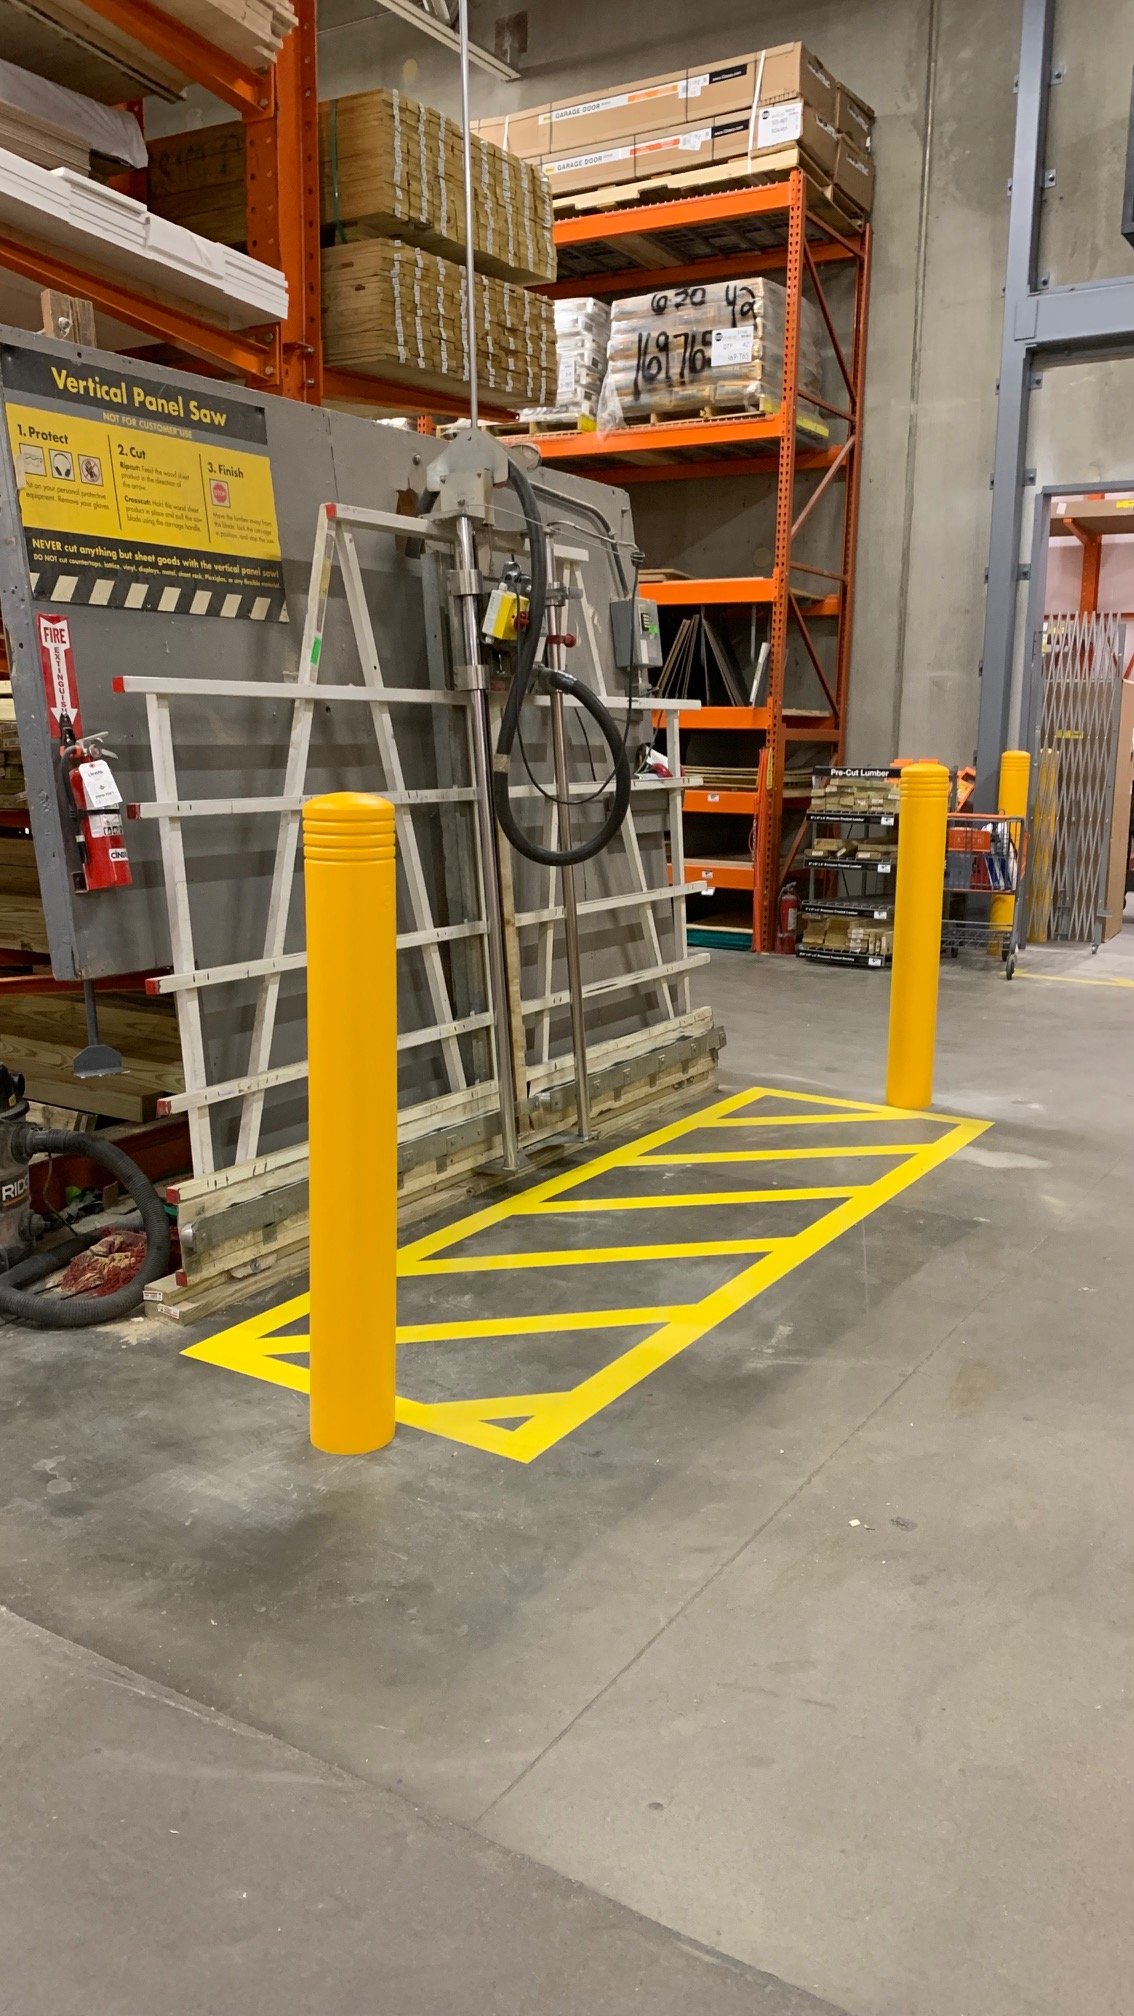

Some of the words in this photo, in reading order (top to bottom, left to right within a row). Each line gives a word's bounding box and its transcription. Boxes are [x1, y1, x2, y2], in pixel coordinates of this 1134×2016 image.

[555, 108, 580, 119] GARAGE
[582, 103, 600, 113] DOOR
[557, 160, 582, 171] GARAGE
[584, 155, 602, 165] DOOR
[51, 366, 127, 404] Vertical
[133, 386, 184, 417] Panel
[188, 400, 227, 427] Saw
[17, 424, 27, 437] 1.
[28, 425, 68, 444] Protect
[102, 412, 119, 423] NOT
[121, 414, 137, 426] FOR
[139, 418, 180, 435] CUSTOMER
[179, 428, 193, 439] USE
[117, 443, 128, 456] 2.
[129, 446, 146, 460] Cut
[207, 461, 217, 473] 3.
[218, 463, 244, 479] Finish
[32, 538, 62, 552] NEVER
[64, 543, 77, 553] cut
[79, 545, 117, 560] anything
[118, 548, 132, 560] but
[134, 550, 156, 563] sheet
[157, 556, 180, 566] goods
[182, 558, 199, 568] with
[200, 560, 212, 570] the
[213, 563, 240, 574] vertical
[241, 567, 261, 577] panel
[44, 554, 57, 562] NOT
[43, 627, 67, 644] FIRE
[830, 768, 859, 777] Pre-Cut
[860, 769, 889, 777] Lumber
